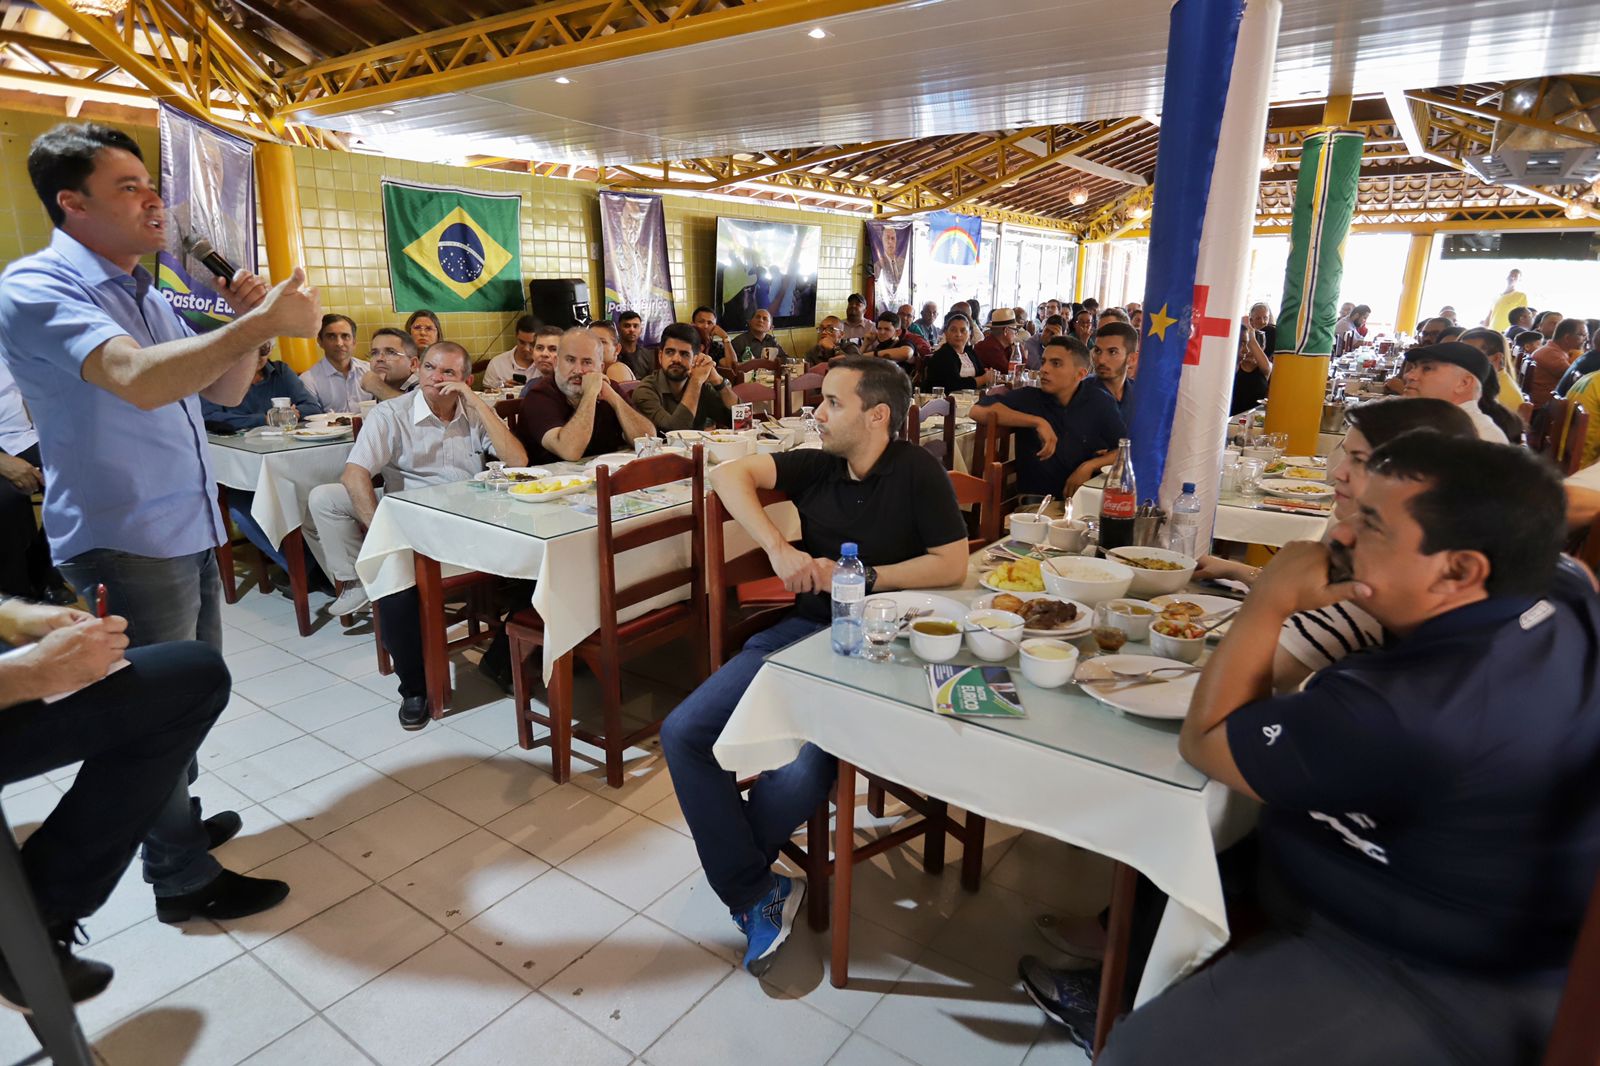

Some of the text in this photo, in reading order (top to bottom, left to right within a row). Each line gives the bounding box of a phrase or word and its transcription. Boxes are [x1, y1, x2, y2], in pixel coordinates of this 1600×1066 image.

[161, 289, 235, 314] Pastor Eu
[961, 685, 979, 711] EURICO
